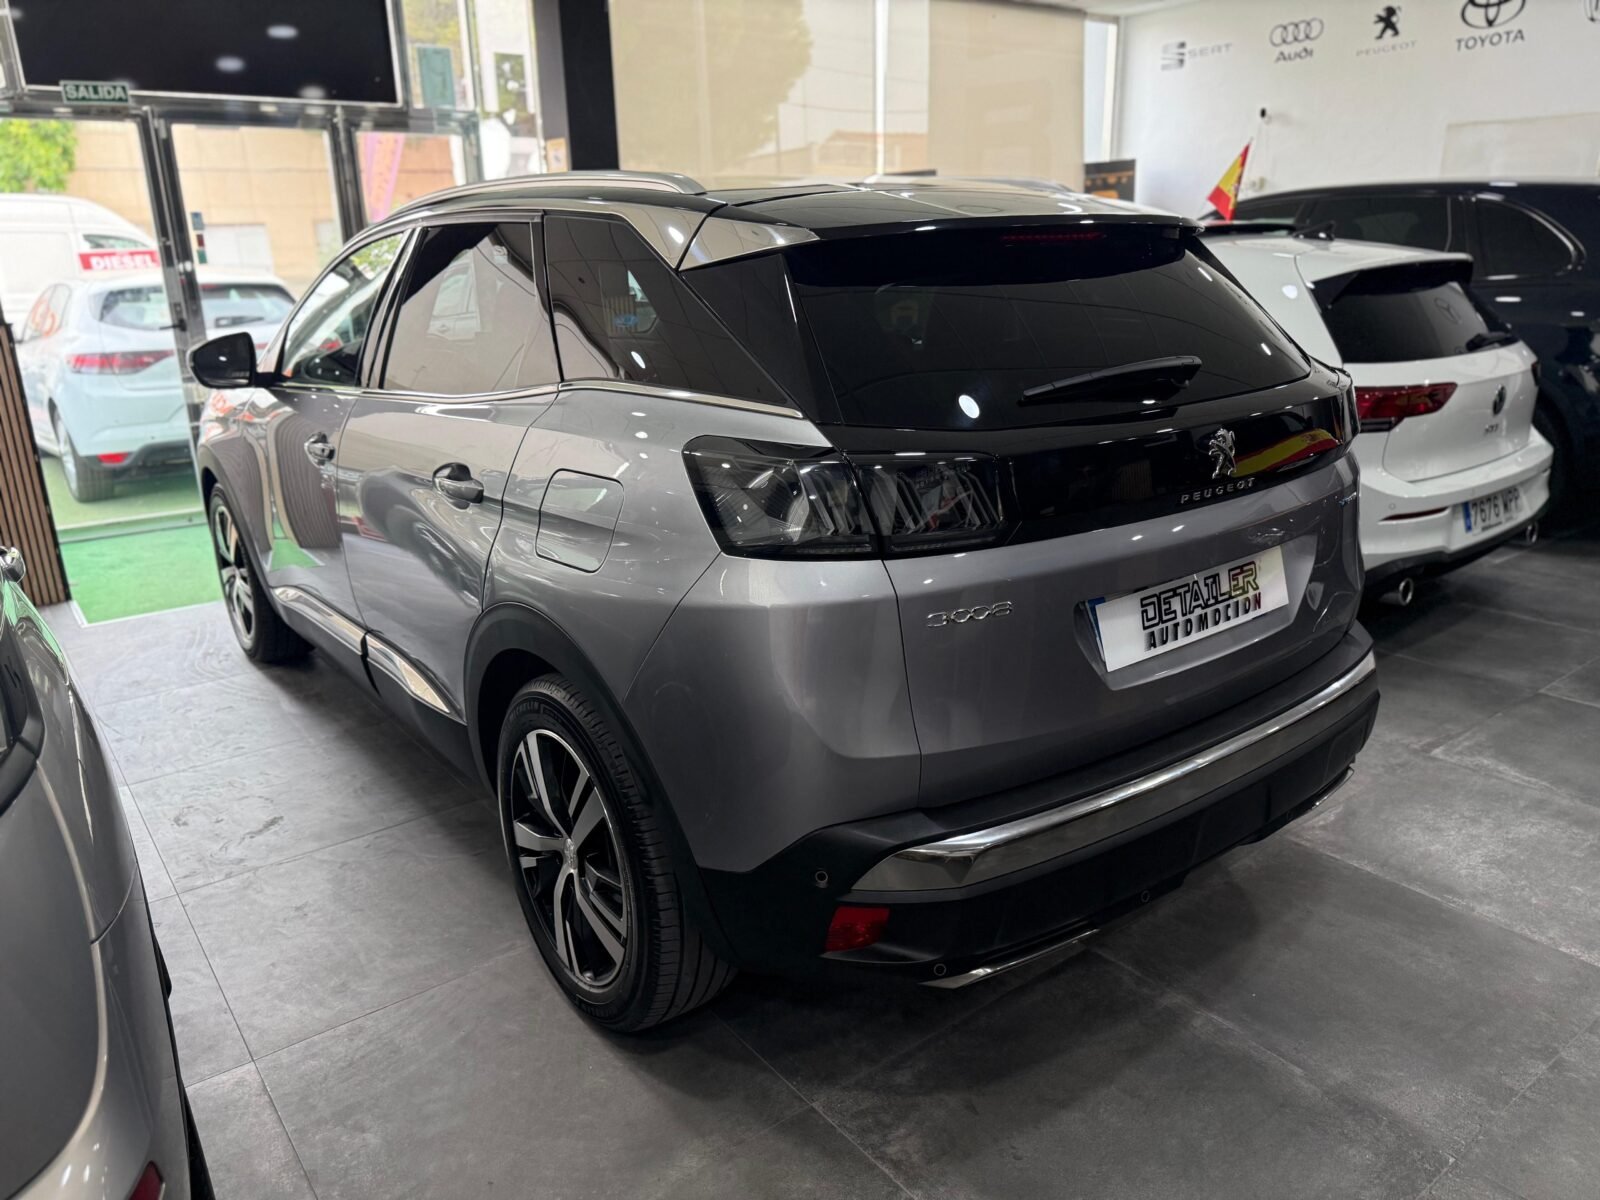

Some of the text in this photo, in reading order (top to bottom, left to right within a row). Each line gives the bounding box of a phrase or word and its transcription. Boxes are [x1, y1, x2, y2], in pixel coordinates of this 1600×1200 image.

[1356, 40, 1418, 57] PEUGEOT
[1455, 29, 1526, 52] TOYOTA
[1274, 48, 1315, 63] Audi
[65, 84, 127, 101] SALIDA
[90, 253, 157, 270] DIESEL
[1180, 477, 1256, 504] PEUGEOT
[1472, 494, 1500, 526] 7676
[1140, 561, 1259, 631] DETAILER
[926, 600, 1013, 628] 3008
[1144, 591, 1261, 652] AUTOMOCION
